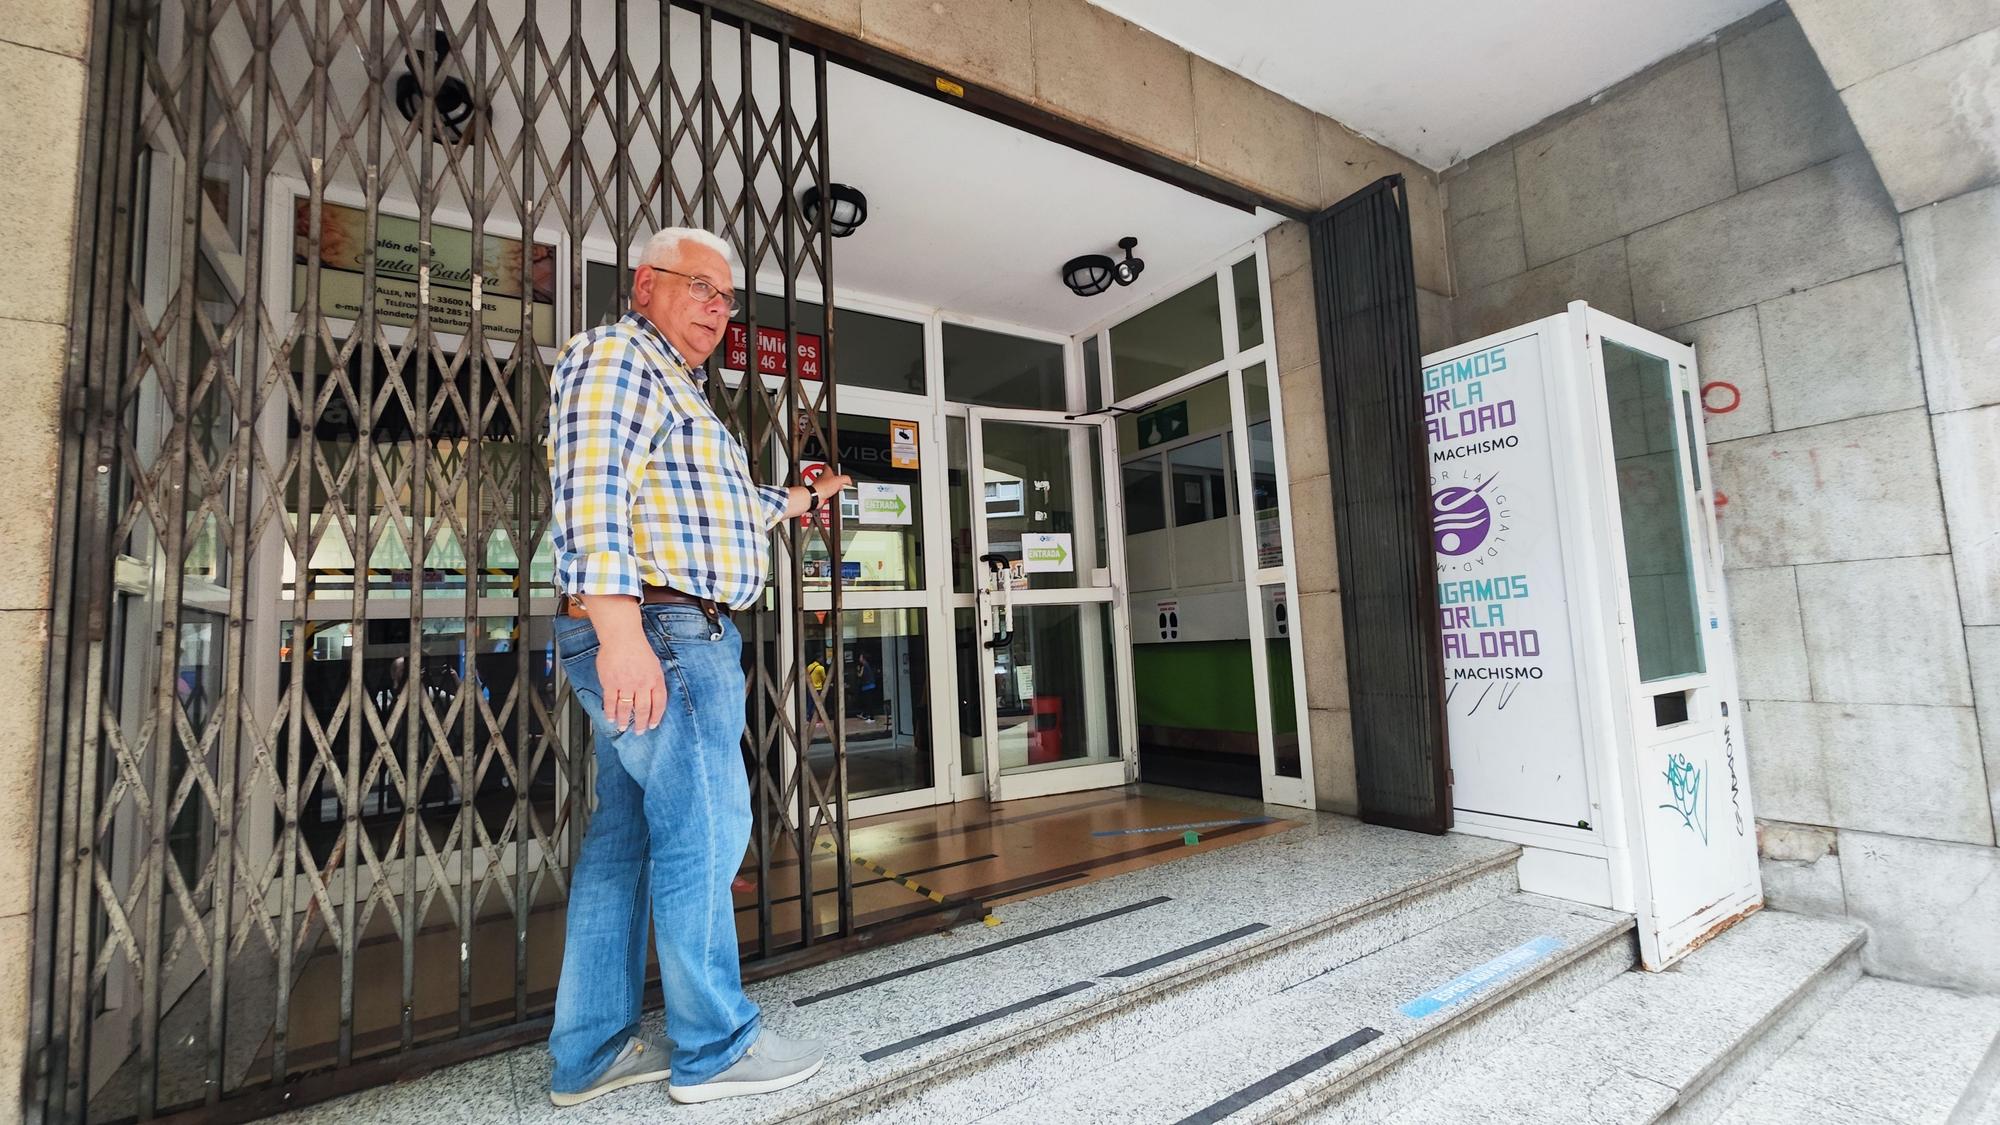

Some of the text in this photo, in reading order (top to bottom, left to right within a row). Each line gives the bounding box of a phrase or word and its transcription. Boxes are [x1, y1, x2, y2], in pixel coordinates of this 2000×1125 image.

[375, 239, 401, 250] alón
[404, 243, 419, 253] de
[430, 259, 500, 287] Barbra
[437, 296, 463, 306] 33600
[446, 307, 463, 316] 285
[732, 350, 747, 366] 98
[760, 354, 776, 370] 46
[802, 360, 817, 376] 44
[1423, 348, 1507, 392] GAMOS
[1425, 399, 1517, 445] ALDAD
[1433, 435, 1519, 463] MACHISMO
[1430, 470, 1449, 486] OR
[1463, 469, 1482, 483] LA
[864, 499, 899, 511] ENTRADA
[1028, 549, 1060, 560] ENTRADA
[1438, 574, 1528, 604] IGAMOS
[1441, 629, 1540, 659] ALDAD
[1454, 666, 1543, 680] MACHISMO
